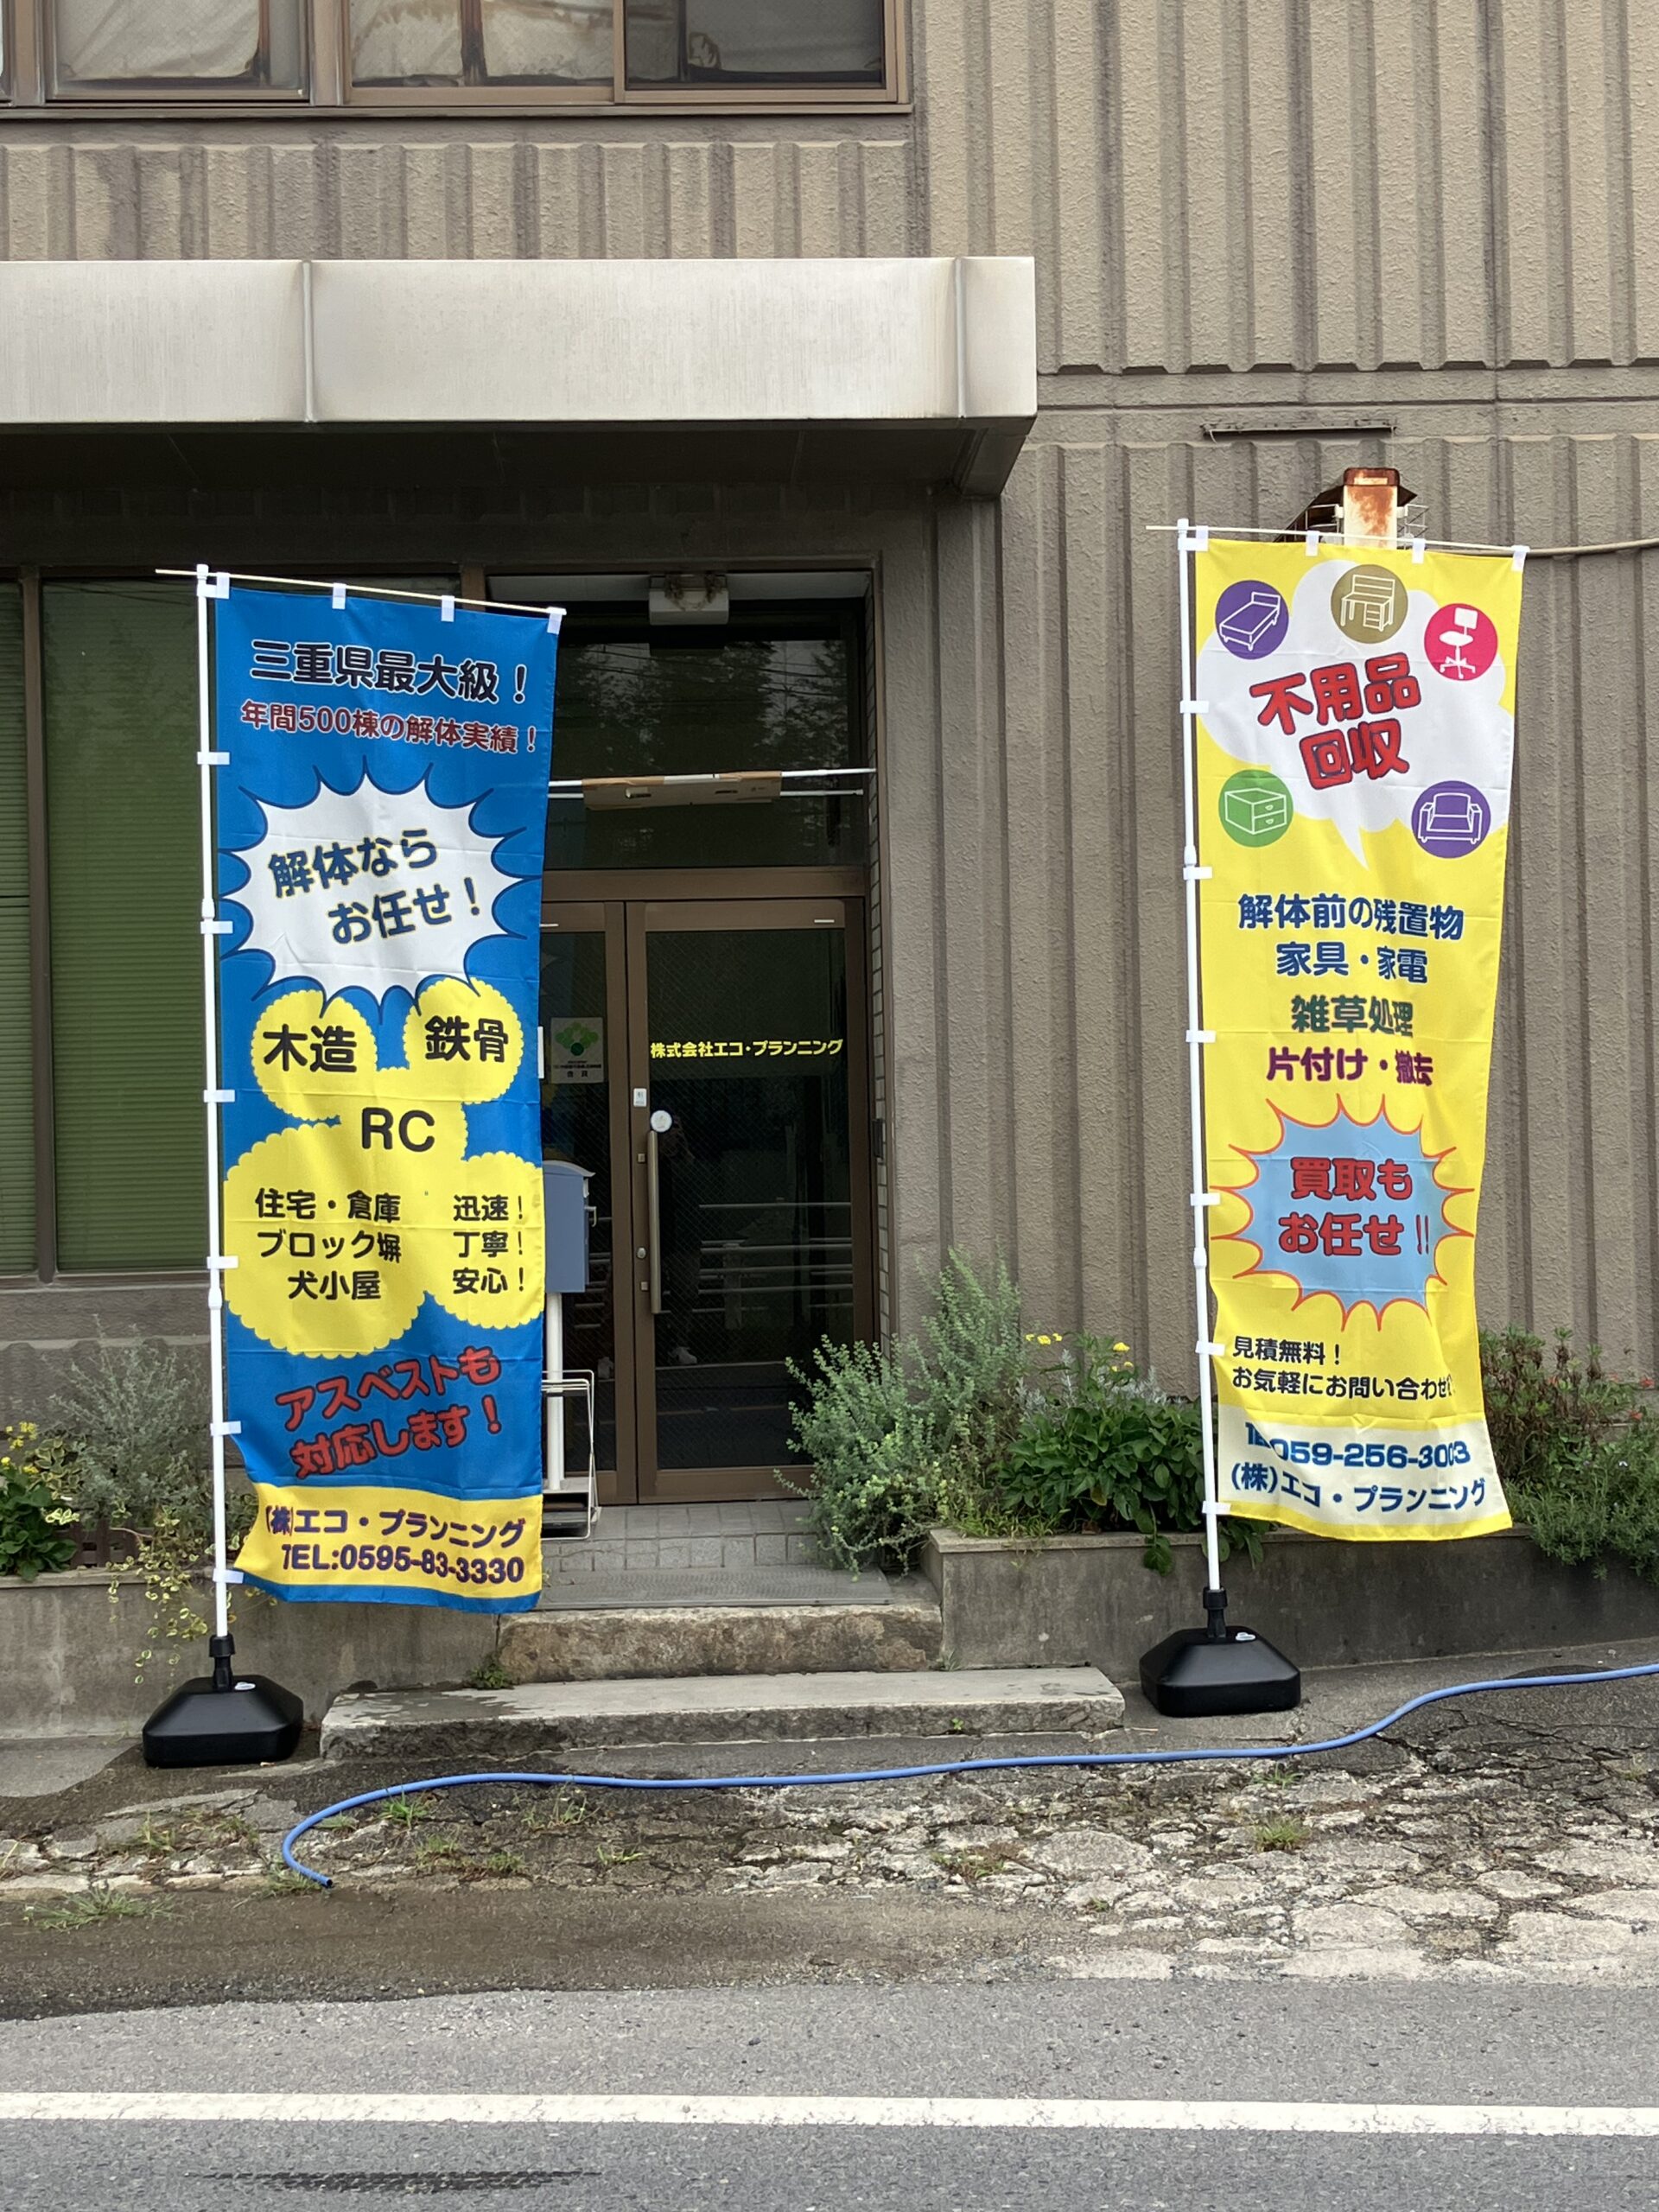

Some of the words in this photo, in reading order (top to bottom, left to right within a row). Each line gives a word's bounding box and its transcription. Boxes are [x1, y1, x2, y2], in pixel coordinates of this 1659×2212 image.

[251, 639, 527, 703] 三重県最大級！
[1249, 652, 1421, 735] 不用品
[240, 699, 537, 754] 年間500棟の解体実績！
[1299, 718, 1410, 790] 回収
[268, 829, 438, 898] 解体なら
[328, 878, 480, 944] お任せ！
[1238, 893, 1465, 940] 解体前の残置物
[1275, 941, 1428, 983] 家具・家電
[424, 1015, 509, 1063] 鉄骨
[1291, 995, 1414, 1038] 雑草処理
[263, 1025, 357, 1072] 木造
[650, 1039, 843, 1058] 株式会社エコ・プランニング
[361, 1107, 435, 1152] RC
[1290, 1156, 1413, 1201] 買取も
[255, 1187, 401, 1223] 住宅・倉庫
[453, 1194, 524, 1221] 迅速！
[257, 1228, 402, 1263] ブロック塀
[453, 1230, 524, 1256] 丁寧！
[288, 1269, 381, 1300] 犬小屋
[453, 1267, 524, 1294] 安心！
[1232, 1335, 1342, 1365] 見積無料！
[275, 1345, 501, 1432] アスベストも
[290, 1395, 501, 1479] 対応します！
[1231, 1462, 1485, 1513] (株)エコ・プランニング
